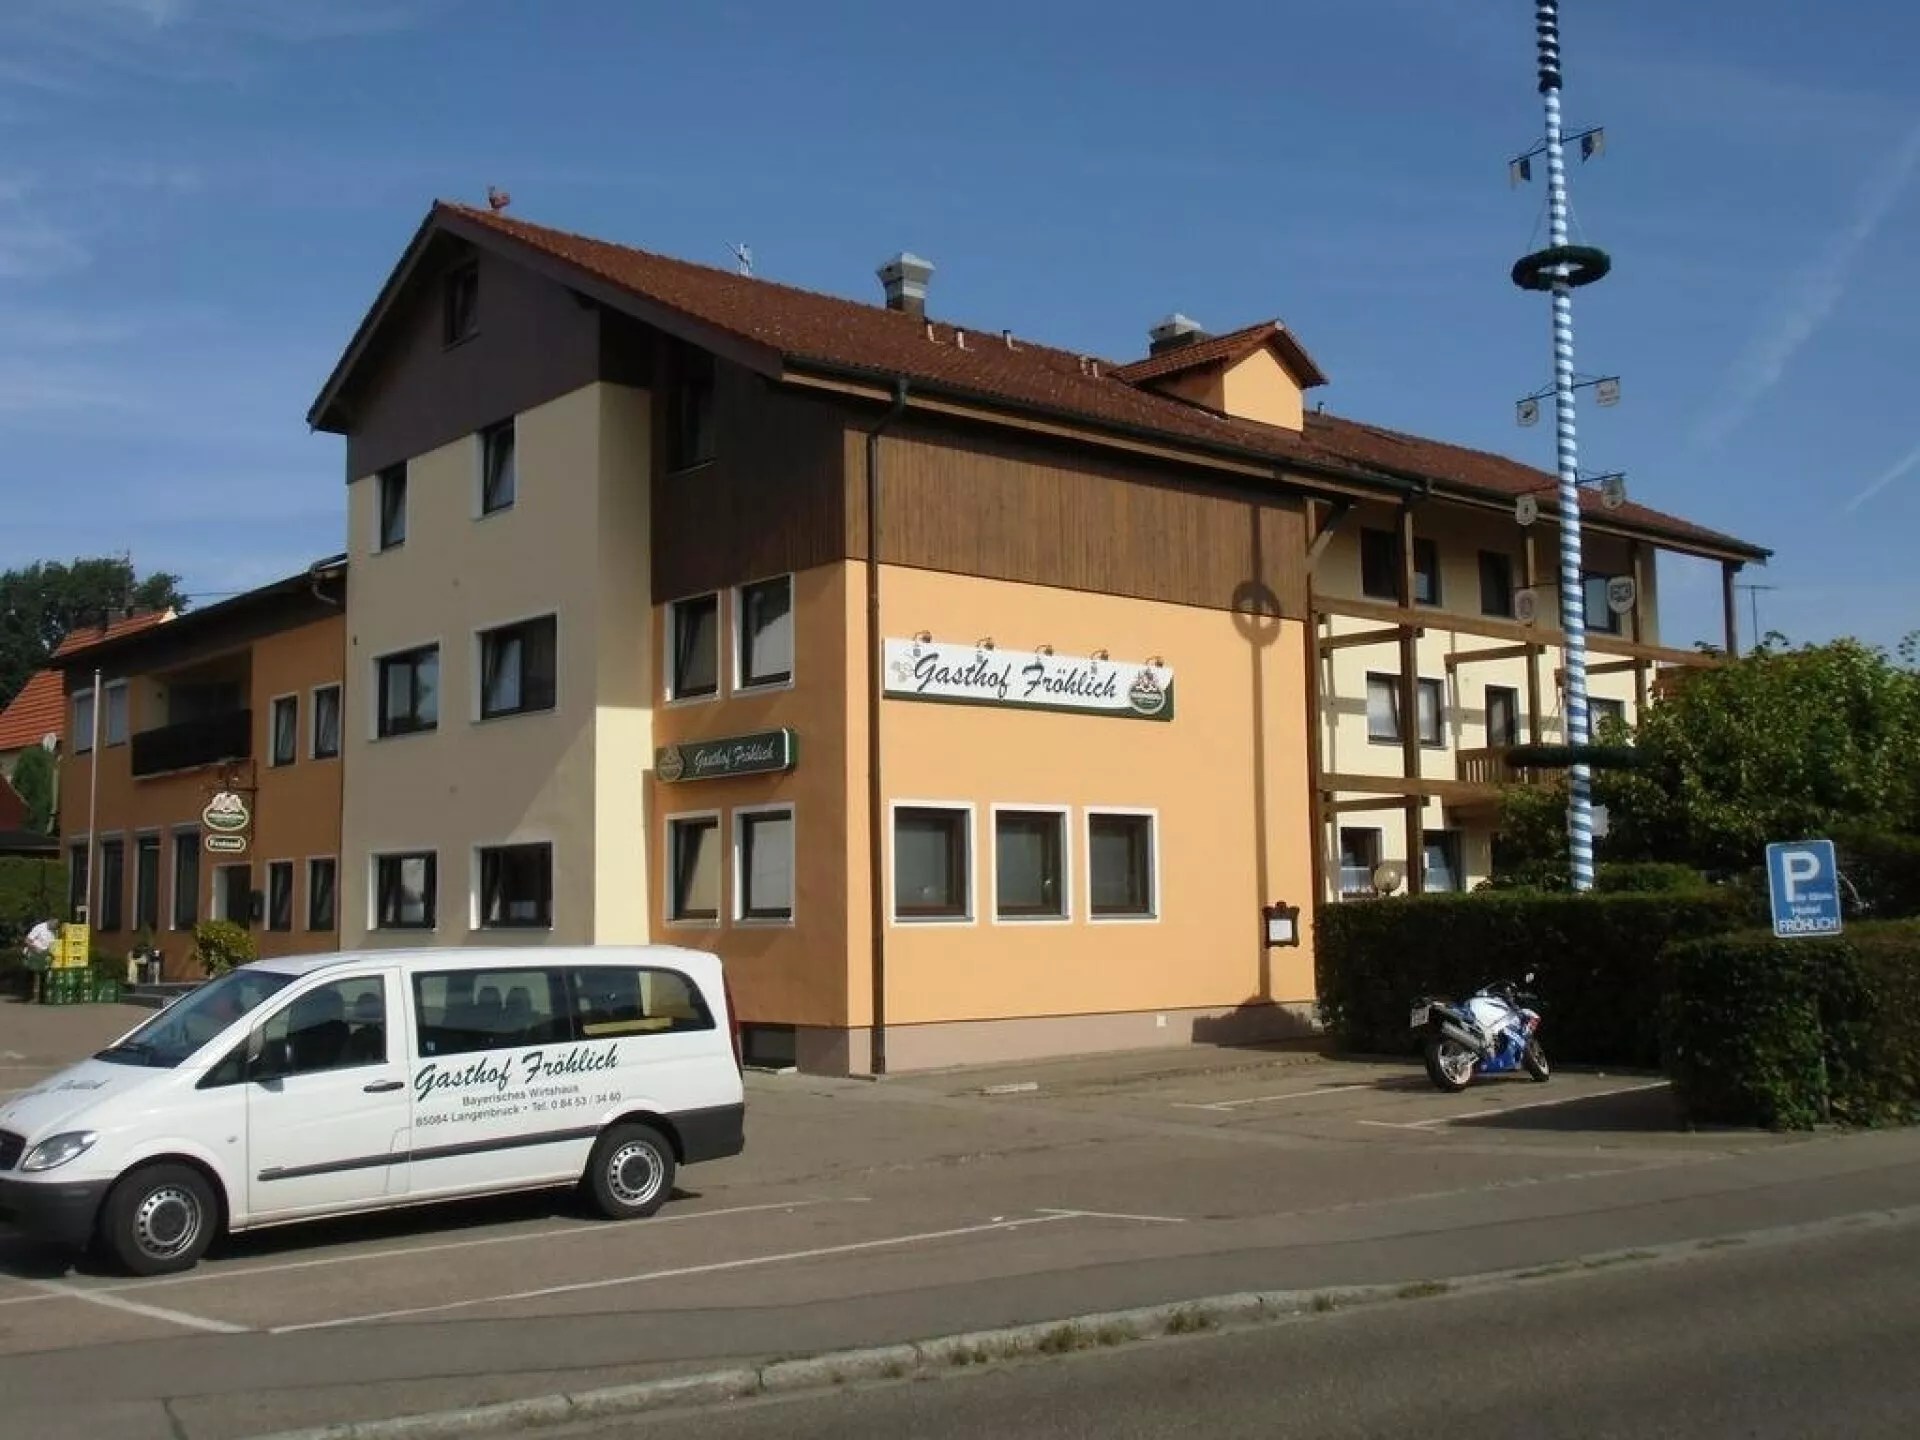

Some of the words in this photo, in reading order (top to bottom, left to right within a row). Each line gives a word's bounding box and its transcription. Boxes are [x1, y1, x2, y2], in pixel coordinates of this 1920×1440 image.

[913, 652, 1011, 699] Gasthof
[1022, 662, 1117, 698] Fröhlich
[1782, 852, 1820, 902] P
[414, 1057, 512, 1102] Gasthof
[521, 1043, 619, 1084] Fröhlich
[462, 1091, 526, 1106] Bayerisches
[530, 1085, 579, 1098] Wirtshaus
